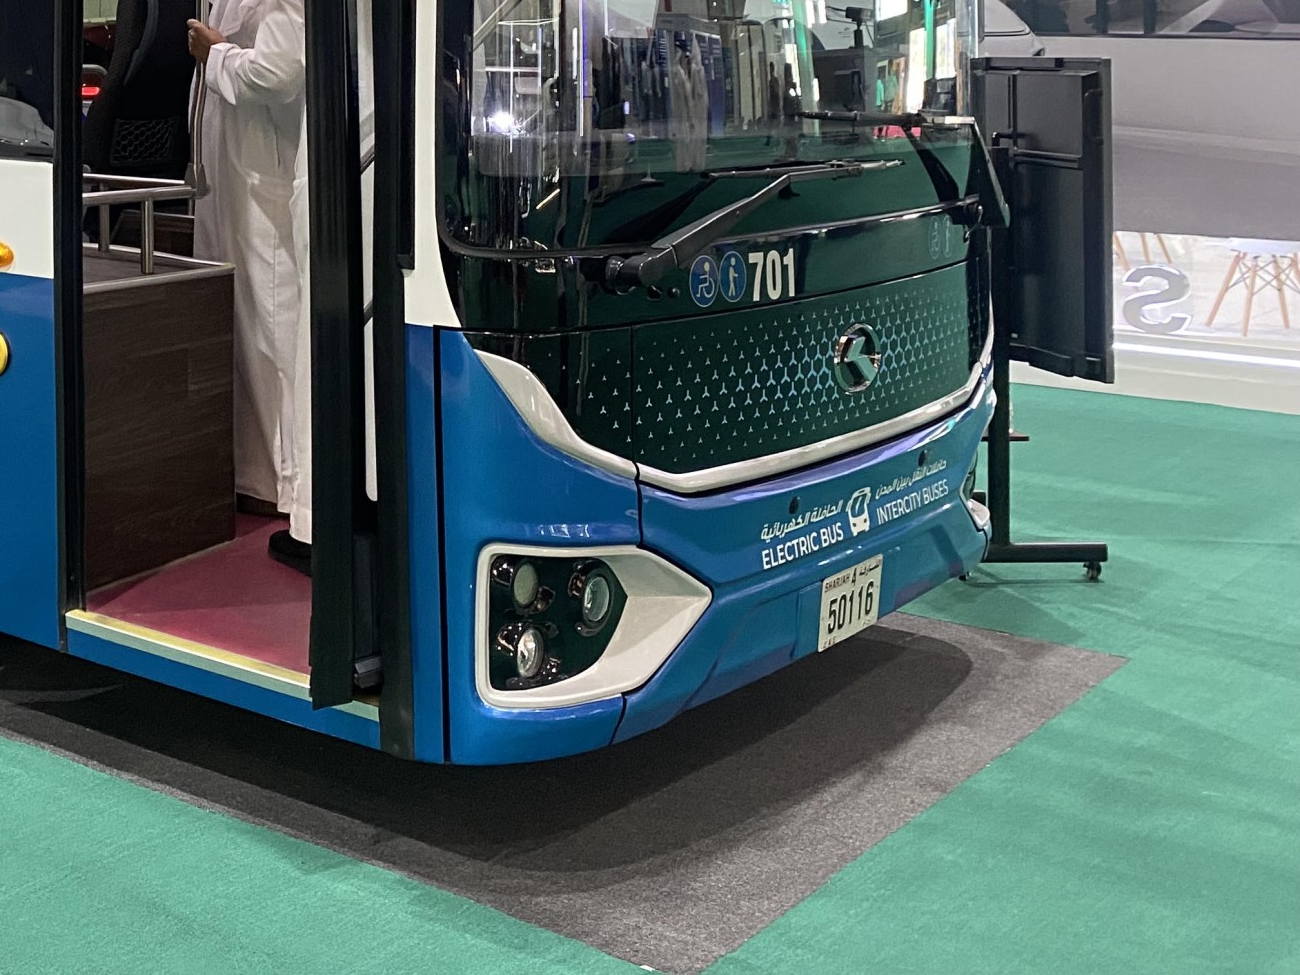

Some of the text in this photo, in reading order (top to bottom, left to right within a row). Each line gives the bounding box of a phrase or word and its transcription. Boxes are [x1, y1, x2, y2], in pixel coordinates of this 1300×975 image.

[749, 248, 795, 301] 701
[875, 459, 947, 499] حافلات النقل بين المدن
[876, 479, 949, 525] INTERCITY BUSES
[760, 500, 843, 543] الحافلة الكهربائية
[762, 522, 844, 570] ELECTRIC BUS
[825, 568, 857, 593] SHARJAH 4
[828, 580, 874, 634] 50116
